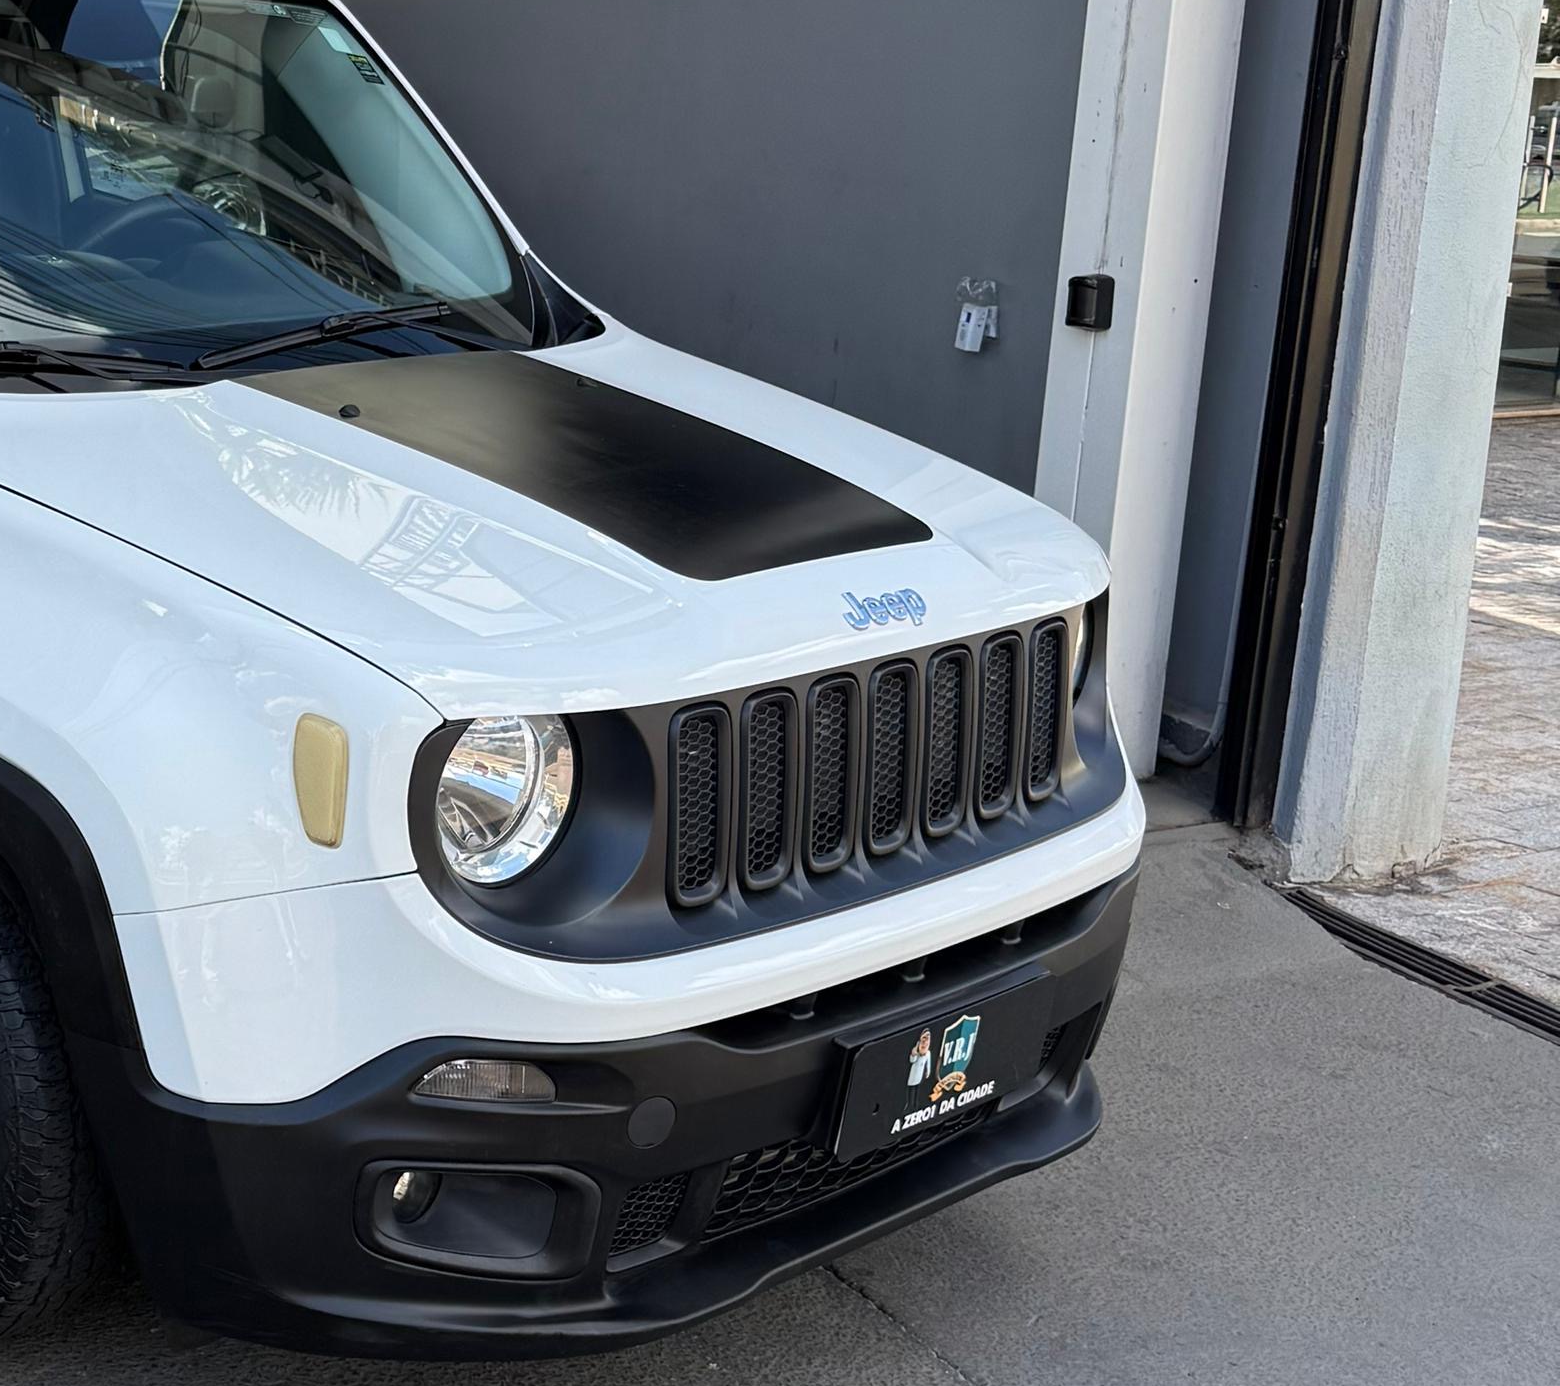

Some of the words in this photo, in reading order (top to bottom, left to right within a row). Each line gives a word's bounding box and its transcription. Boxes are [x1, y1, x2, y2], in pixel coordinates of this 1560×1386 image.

[841, 587, 928, 632] Jeep
[890, 1118, 901, 1134] A
[938, 1096, 956, 1115] DA
[956, 1079, 996, 1107] CIDADE
